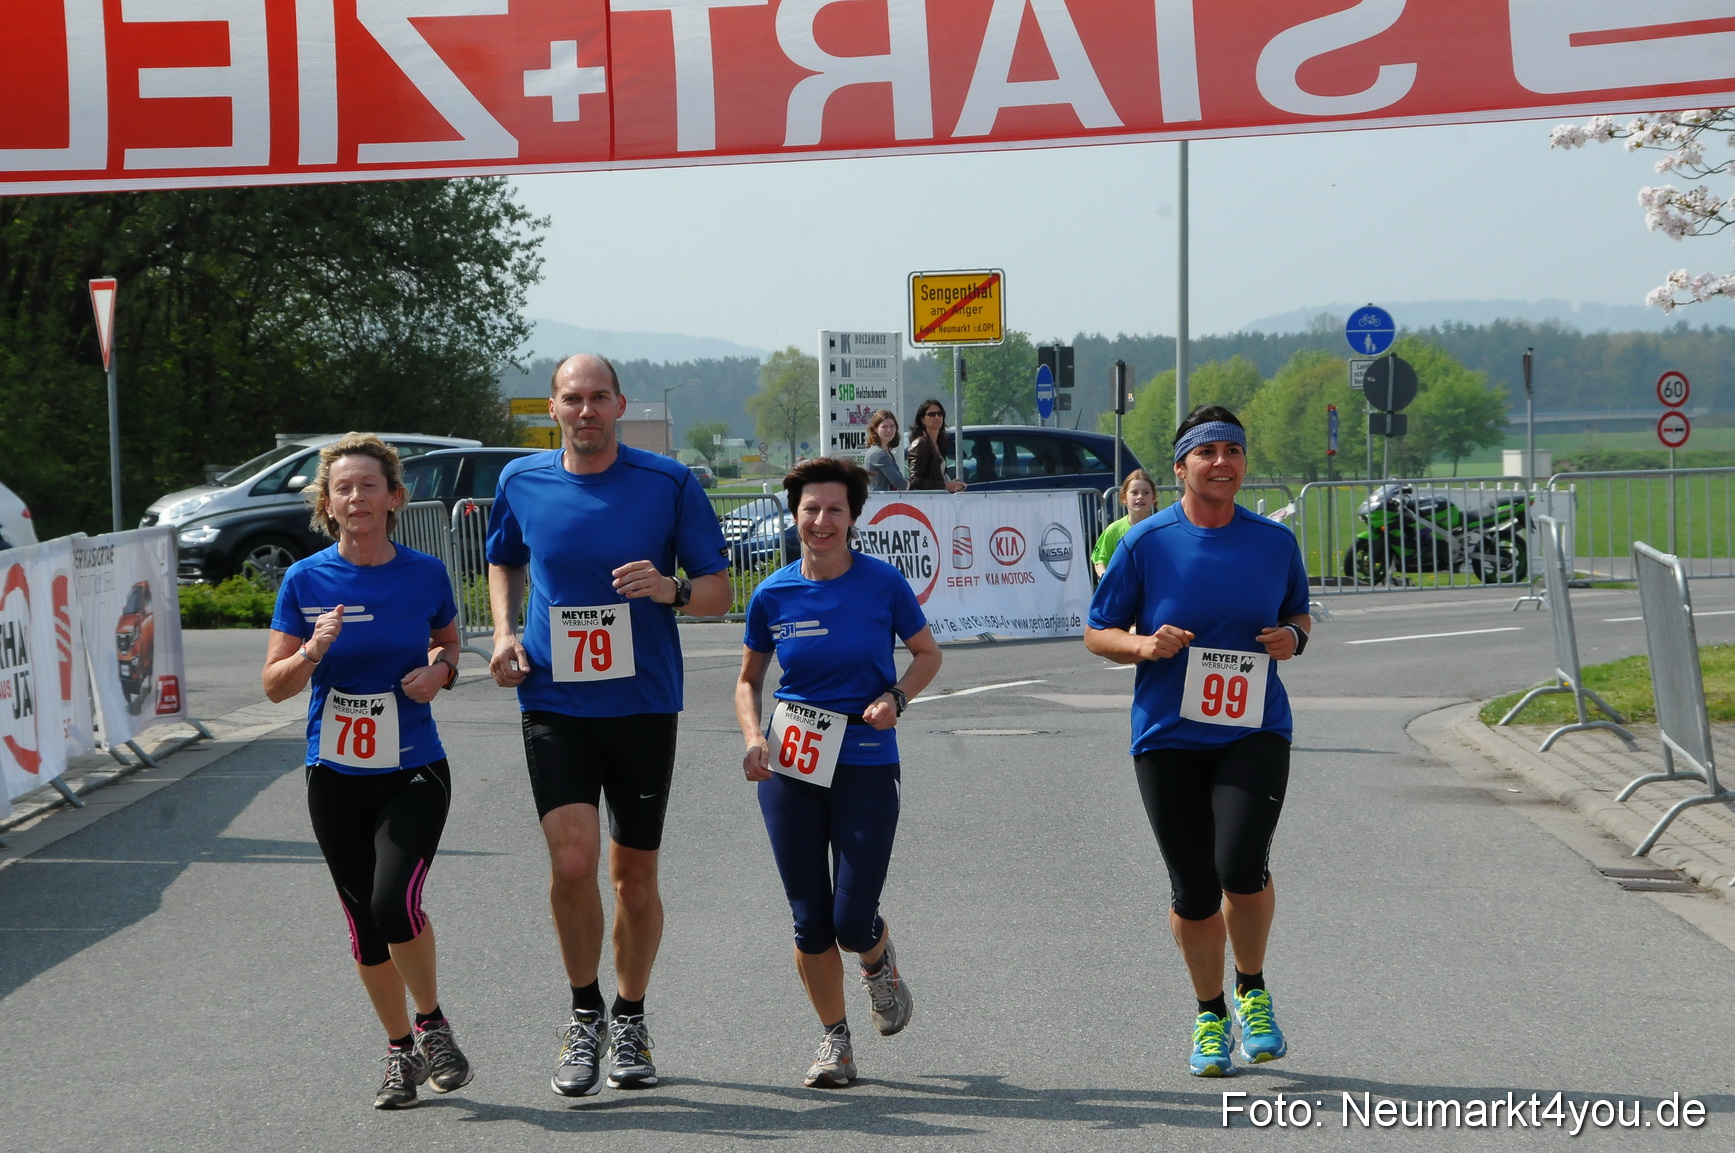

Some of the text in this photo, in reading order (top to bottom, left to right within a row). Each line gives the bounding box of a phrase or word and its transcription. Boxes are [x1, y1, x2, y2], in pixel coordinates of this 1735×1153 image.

[921, 282, 993, 304] Sengenthal
[930, 305, 984, 317] am Anger
[939, 324, 971, 333] Neumarkt
[855, 334, 886, 345] HOLZAMMER
[856, 358, 887, 369] HOLZAMMER
[838, 383, 856, 402] SHB
[1664, 381, 1683, 398] 60
[838, 432, 866, 450] THULE
[847, 530, 929, 554] GERHART &
[995, 536, 1020, 557] KIA
[946, 576, 980, 587] SEAT
[985, 571, 1036, 586] KIA MOTORS
[561, 618, 600, 627] WERBUNG
[562, 610, 598, 620] MEYER
[567, 628, 613, 673] 79
[1202, 652, 1239, 664] MEYER
[1201, 661, 1239, 671] WERBUNG
[333, 694, 368, 708] MEYER
[1201, 673, 1249, 719] 99
[332, 703, 368, 715] WERBUNG
[786, 702, 817, 720] MEYER
[785, 711, 816, 727] WERBUNG
[335, 713, 377, 760] 78
[778, 724, 824, 775] 65
